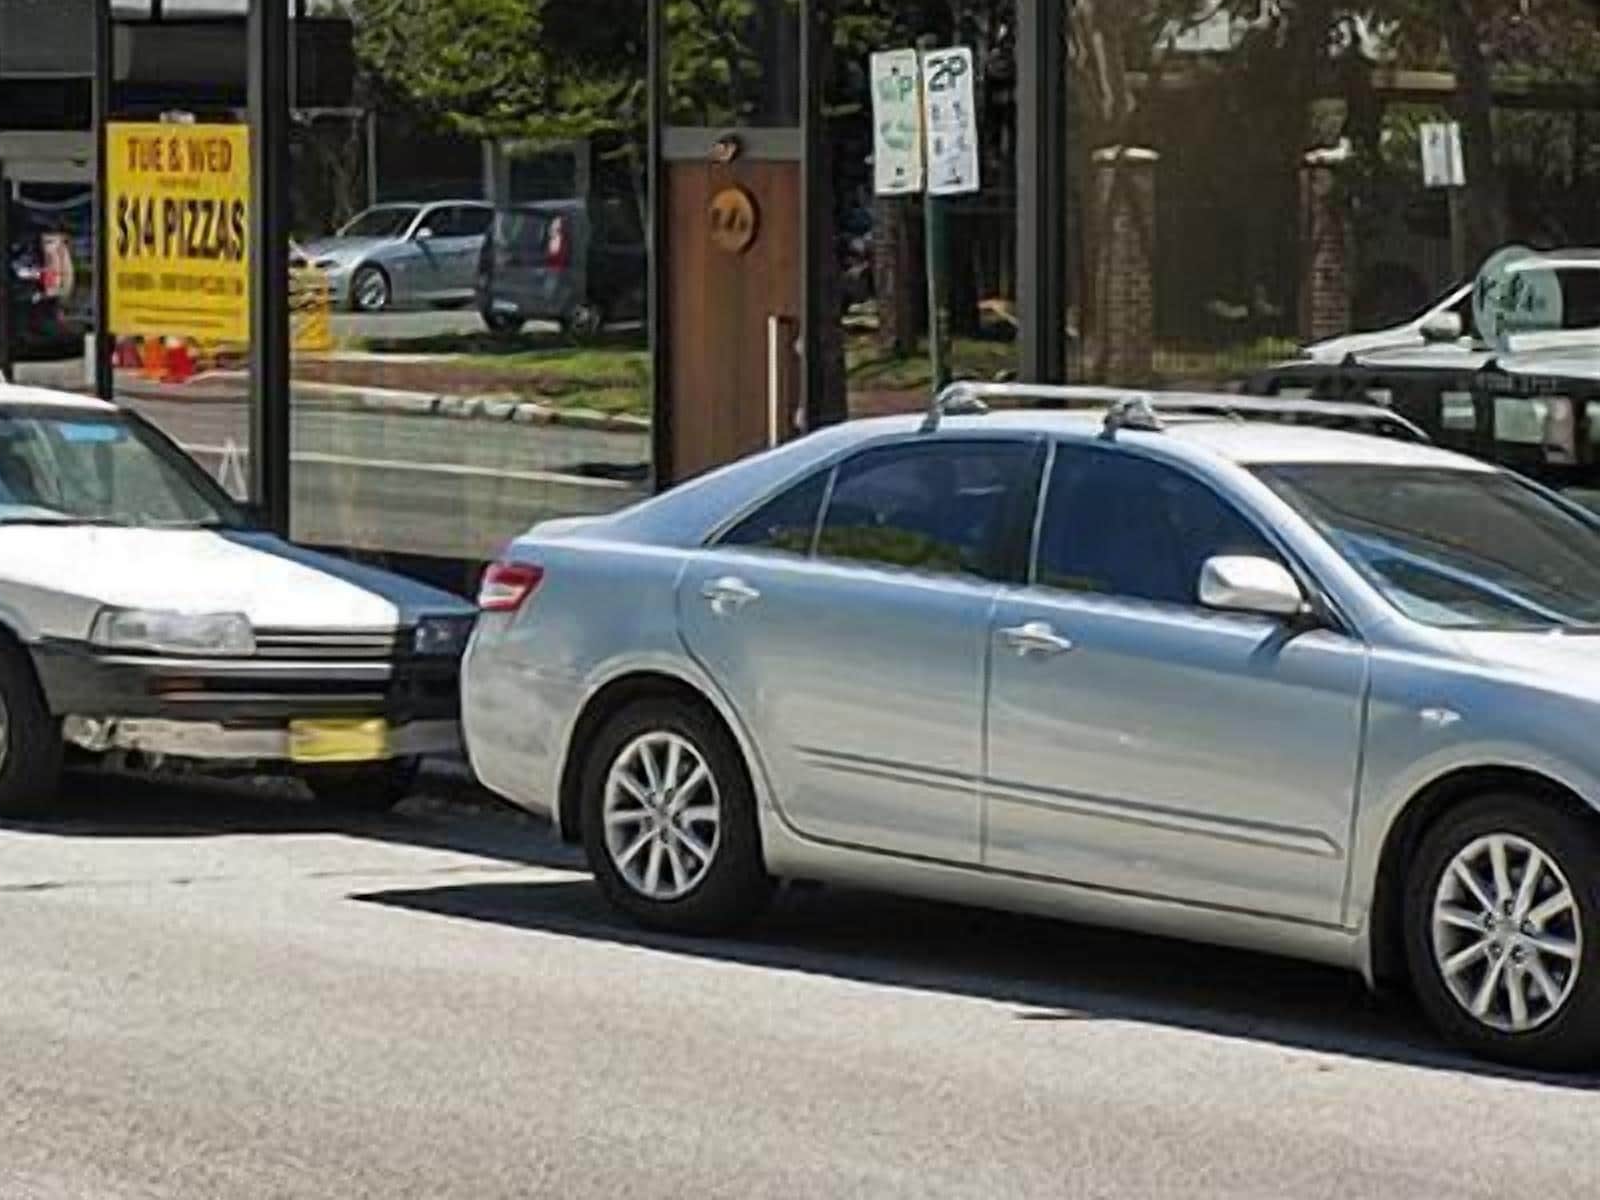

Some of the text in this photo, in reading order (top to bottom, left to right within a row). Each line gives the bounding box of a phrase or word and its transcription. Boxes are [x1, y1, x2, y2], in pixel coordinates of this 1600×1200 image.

[927, 55, 969, 92] 2P
[127, 137, 163, 173] TUE
[186, 137, 233, 173] WED
[117, 195, 245, 261] $14 PIZZAS
